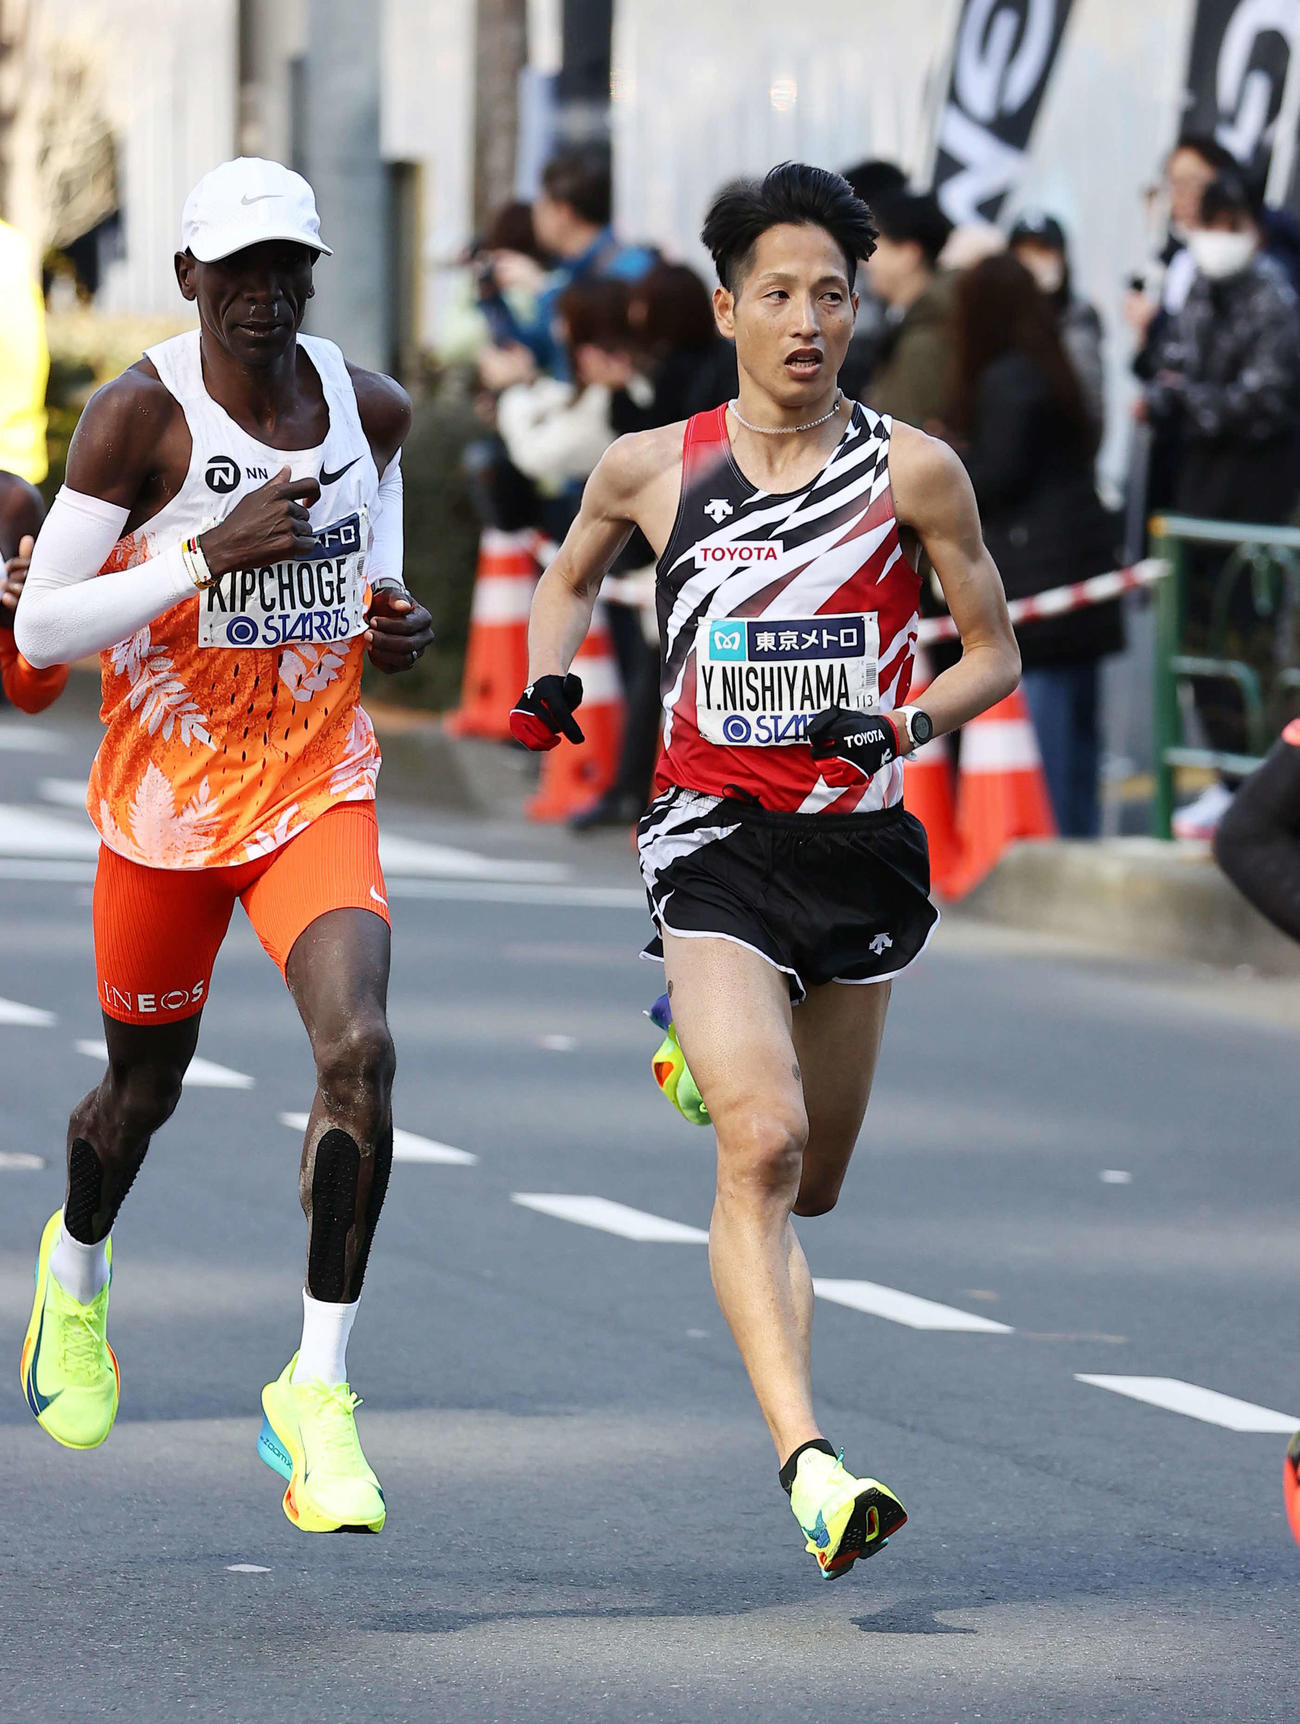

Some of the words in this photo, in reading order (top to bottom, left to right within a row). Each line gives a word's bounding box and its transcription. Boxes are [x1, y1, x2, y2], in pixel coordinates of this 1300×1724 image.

[245, 466, 269, 480] NN
[700, 546, 778, 562] TOYOTA
[206, 557, 348, 613] KIPCHOGE
[754, 627, 858, 652] 東京メトロ
[701, 663, 849, 712] Y.NISHIYAMA
[856, 694, 873, 708] 113
[754, 713, 818, 744] STA
[843, 728, 886, 749] TOYOTA
[103, 979, 205, 1013] INEOS
